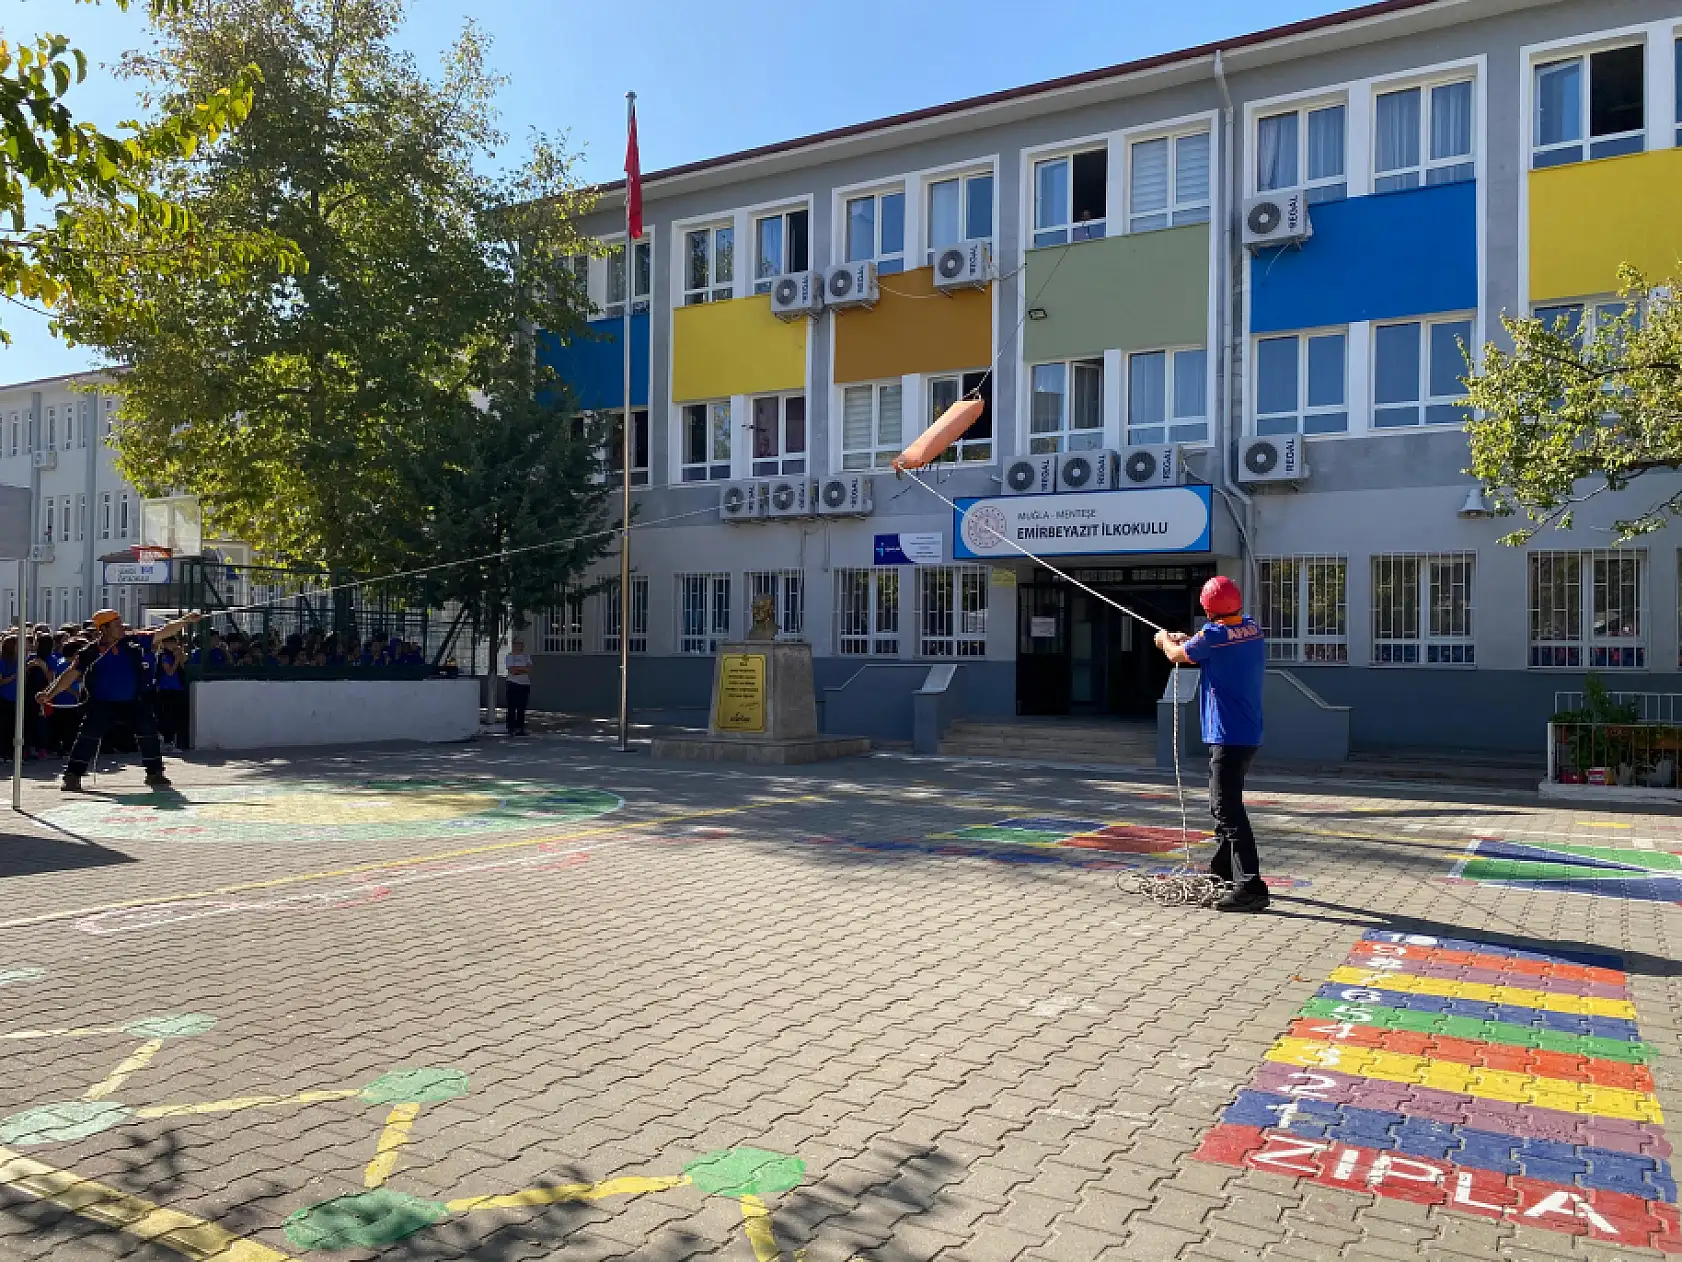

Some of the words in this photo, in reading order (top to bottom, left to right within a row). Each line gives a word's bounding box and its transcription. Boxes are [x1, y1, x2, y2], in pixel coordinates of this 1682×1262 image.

[1288, 194, 1298, 230] REGAL
[1162, 448, 1172, 479] REGAL
[1285, 438, 1295, 472] REGAL
[1097, 454, 1106, 486] REGAL
[1017, 523, 1099, 540] EMİRBEYAZIT
[1101, 520, 1168, 536] İLKOKULU
[1372, 943, 1407, 956] 9
[1384, 932, 1438, 946] 10
[1340, 988, 1382, 1002] 6
[1330, 1005, 1374, 1022] 5
[1309, 1023, 1357, 1039] 4
[1297, 1044, 1341, 1066] 3
[1277, 1072, 1337, 1098] 2
[1265, 1102, 1298, 1128] 1
[1249, 1134, 1619, 1234] ZIPLA
